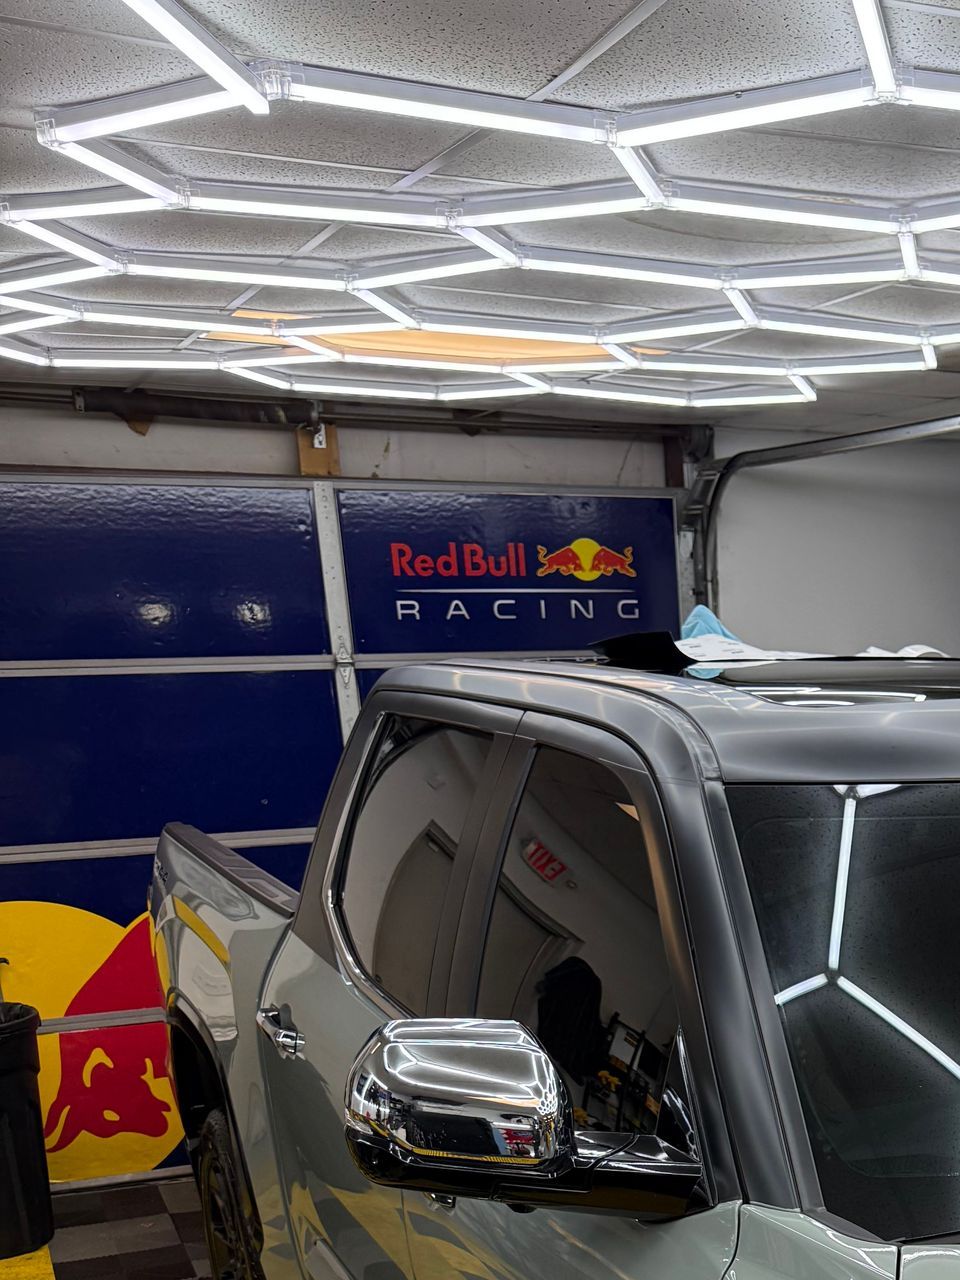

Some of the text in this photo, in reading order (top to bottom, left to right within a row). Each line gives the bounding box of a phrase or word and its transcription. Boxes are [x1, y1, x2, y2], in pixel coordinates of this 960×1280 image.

[390, 541, 527, 577] Red Bull
[395, 599, 640, 620] RACING
